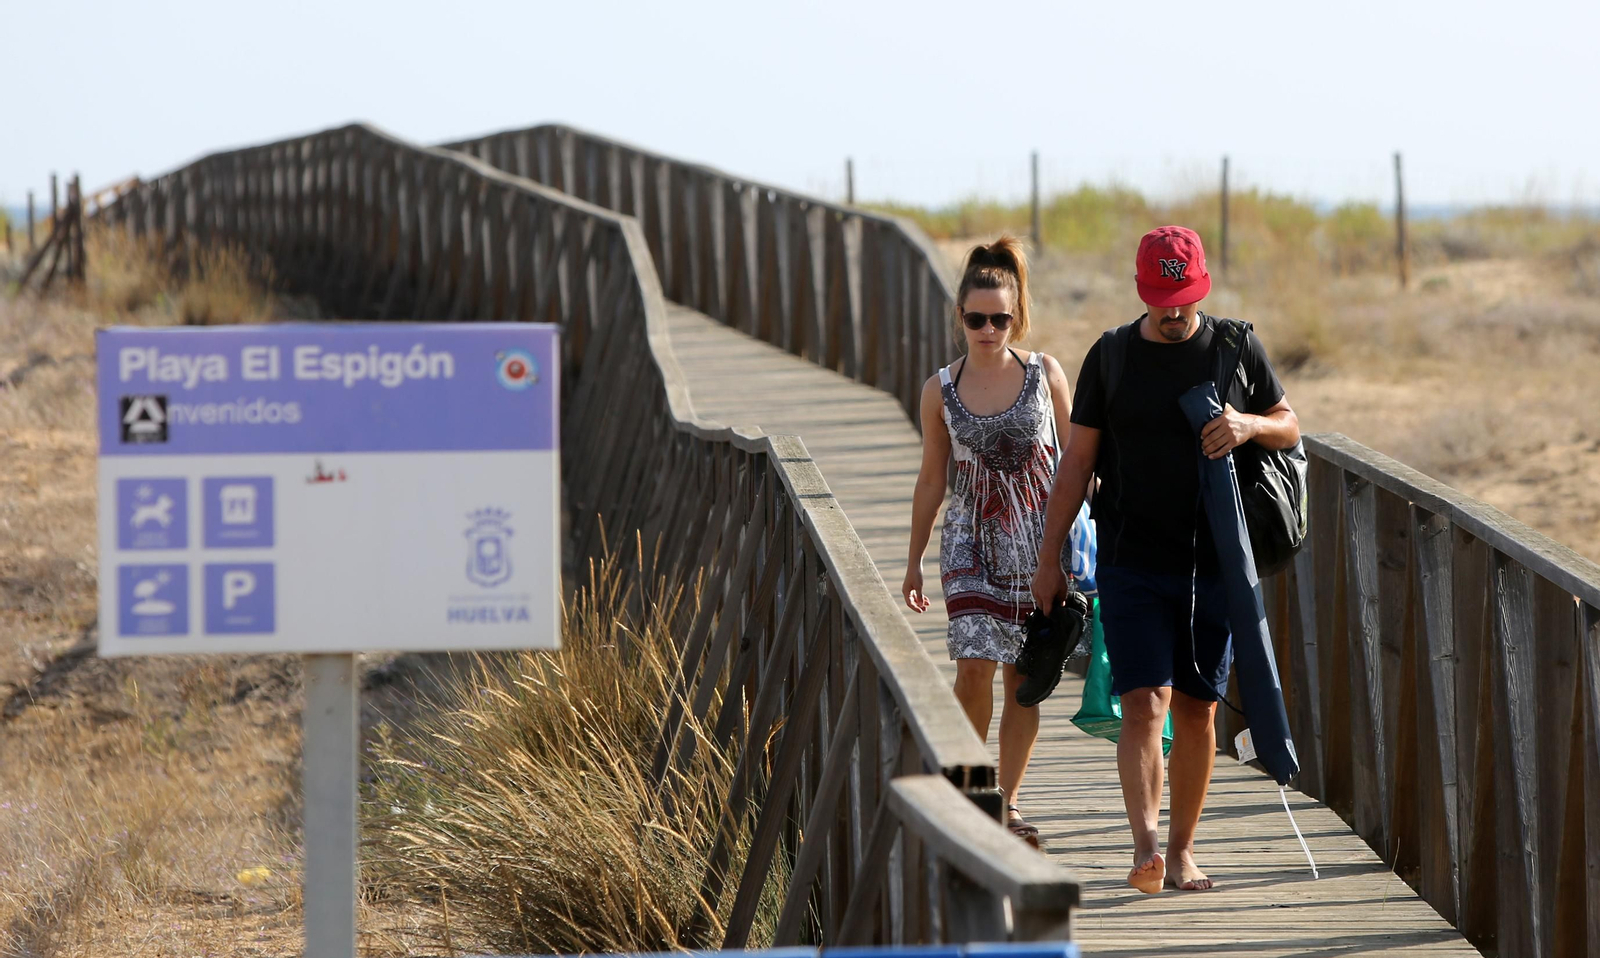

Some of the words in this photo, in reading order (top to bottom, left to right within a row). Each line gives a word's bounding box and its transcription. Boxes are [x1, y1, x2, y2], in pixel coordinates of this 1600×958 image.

[1159, 258, 1187, 282] NY
[119, 347, 227, 390] Playa
[241, 346, 279, 381] El
[293, 344, 454, 388] Espigón
[166, 397, 303, 425] nvenidos
[222, 570, 256, 610] P
[447, 606, 531, 625] HUELVA
